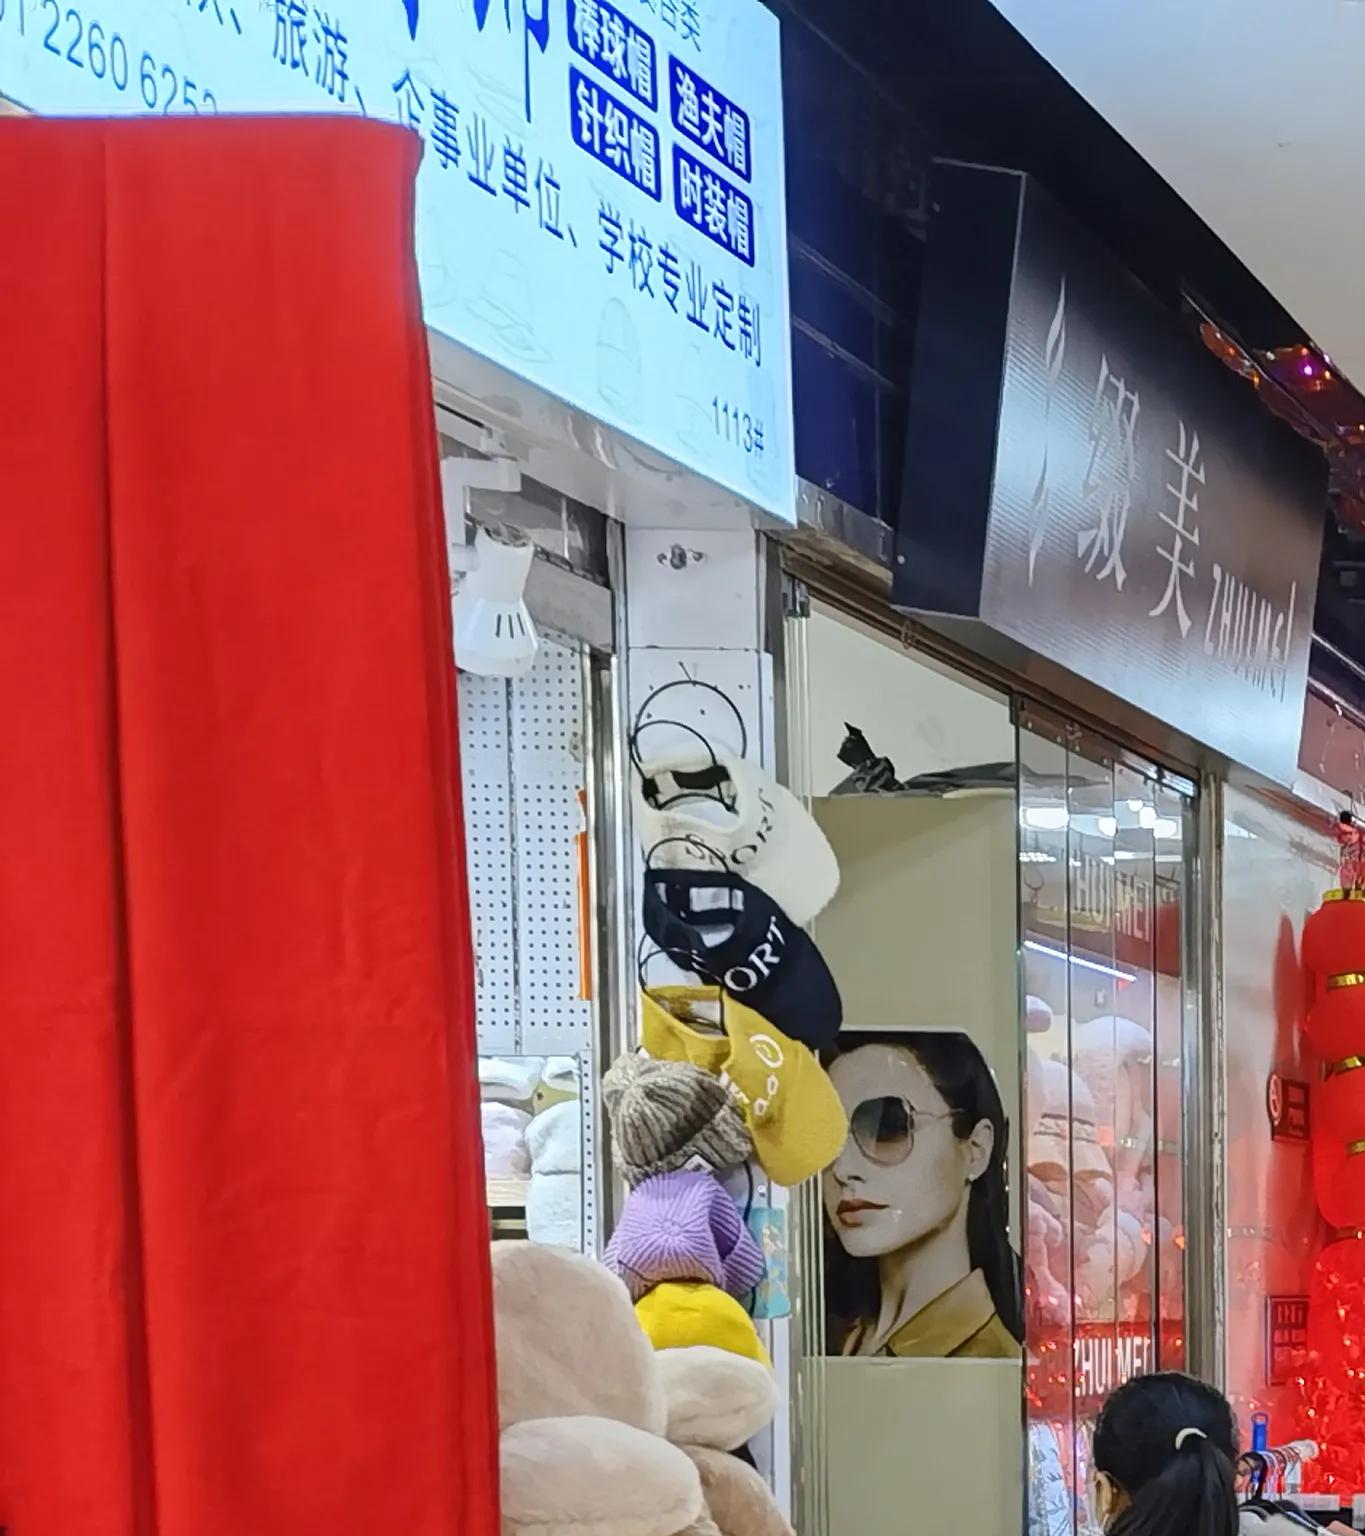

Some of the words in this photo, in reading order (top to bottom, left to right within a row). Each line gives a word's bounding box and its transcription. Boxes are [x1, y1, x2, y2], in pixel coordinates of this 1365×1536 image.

[43, 0, 128, 91] 2260
[576, 78, 657, 194] 针织帽
[675, 64, 747, 175] 渔夫帽
[679, 156, 750, 250] 时装帽
[711, 395, 764, 458] 1113#
